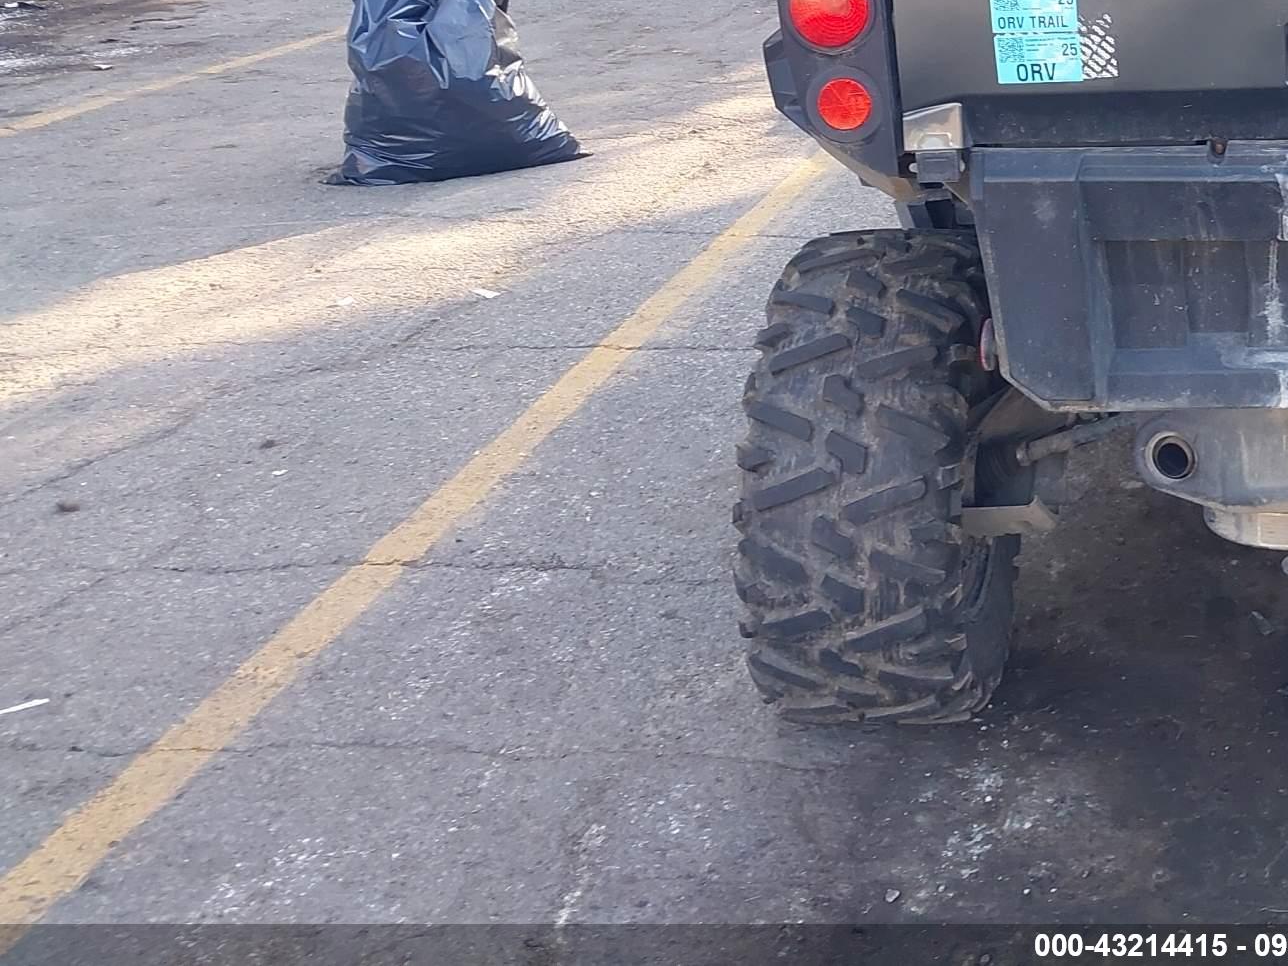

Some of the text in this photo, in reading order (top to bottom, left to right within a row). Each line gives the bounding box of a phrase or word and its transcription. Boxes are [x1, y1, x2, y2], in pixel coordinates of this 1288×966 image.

[997, 15, 1070, 29] ORV TRAIL
[1061, 43, 1078, 56] 25
[1016, 62, 1057, 82] ORV
